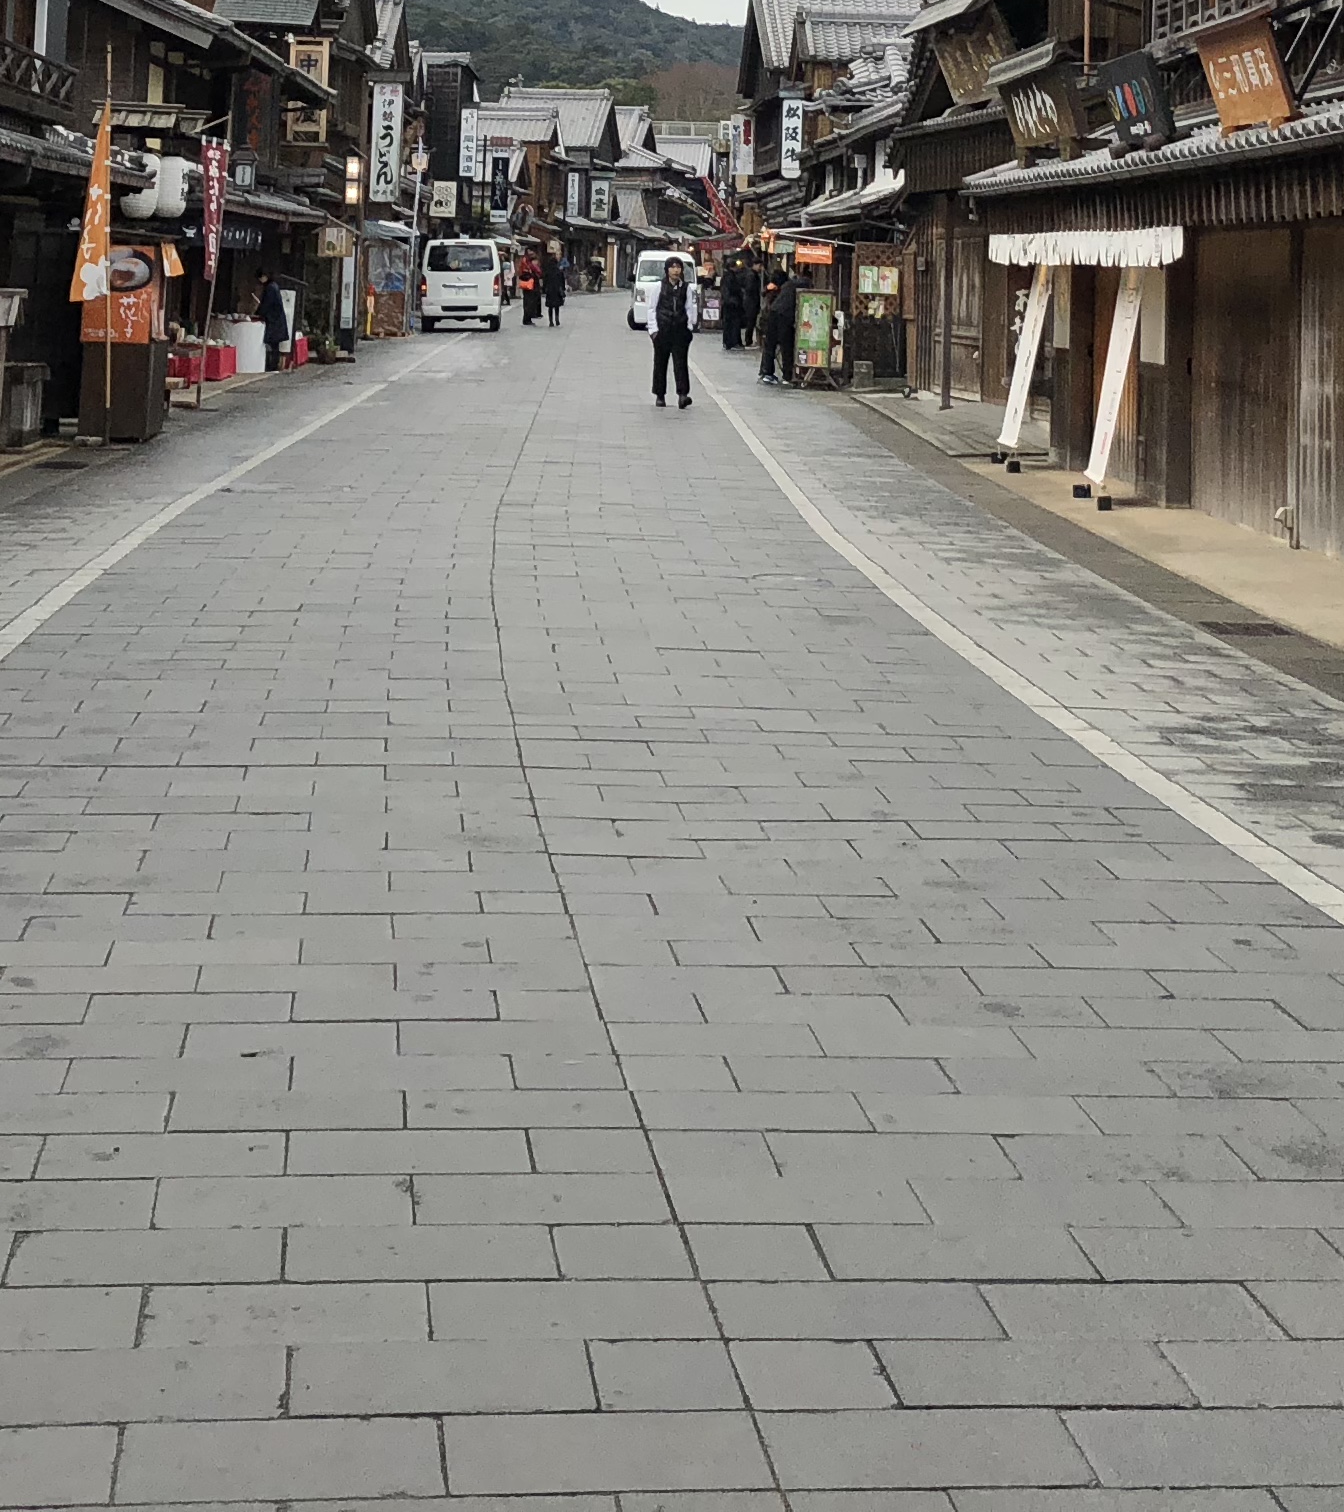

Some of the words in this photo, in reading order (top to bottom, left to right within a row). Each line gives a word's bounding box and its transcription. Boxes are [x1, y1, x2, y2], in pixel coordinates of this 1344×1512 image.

[376, 98, 395, 186] 伊勢うどん
[784, 104, 801, 164] 松阪牛
